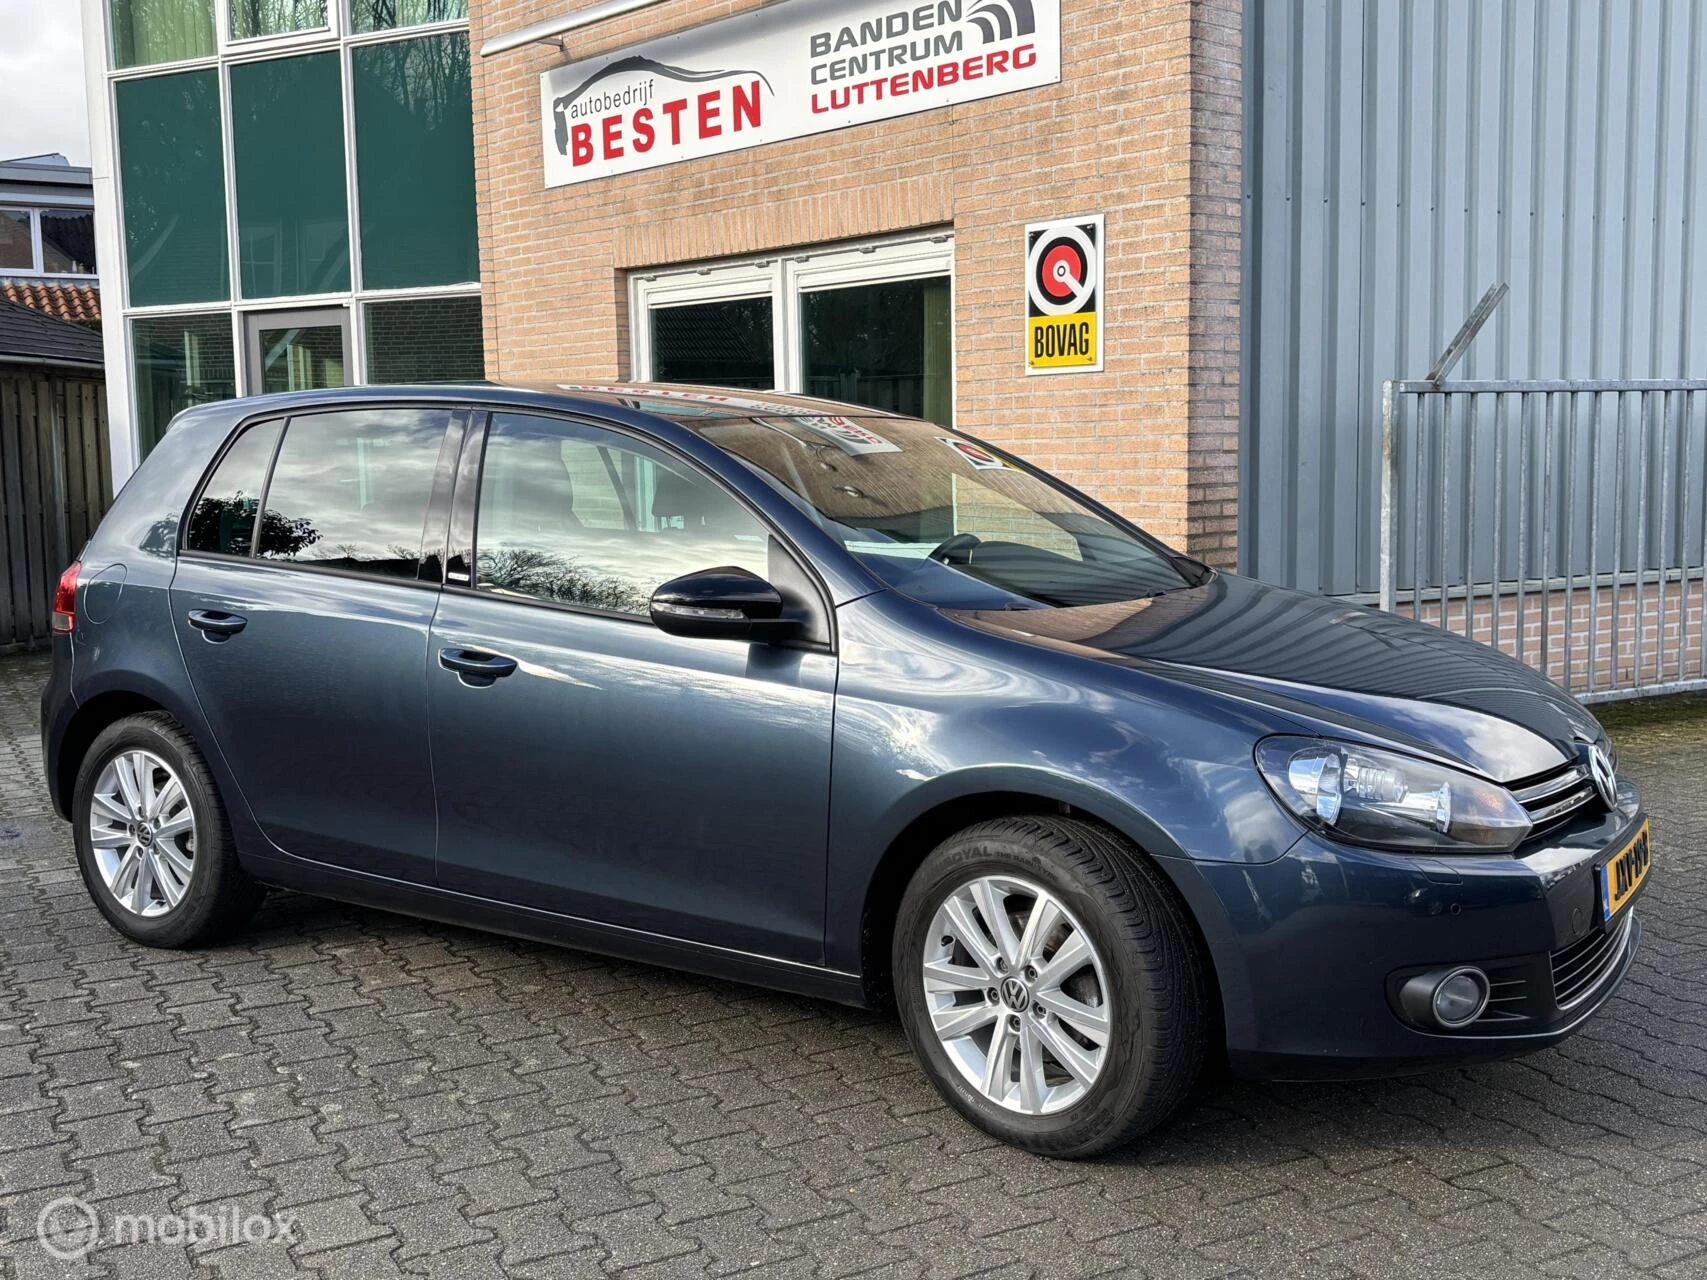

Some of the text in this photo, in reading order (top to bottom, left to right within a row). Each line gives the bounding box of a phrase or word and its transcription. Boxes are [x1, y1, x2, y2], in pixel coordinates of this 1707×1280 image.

[810, 0, 962, 58] BANDEN
[811, 30, 963, 85] CENTRUM
[811, 43, 1037, 114] LUTTENBERG
[571, 79, 654, 118] autobedrijf
[571, 80, 761, 167] BESTEN
[1034, 322, 1089, 358] BOVAG
